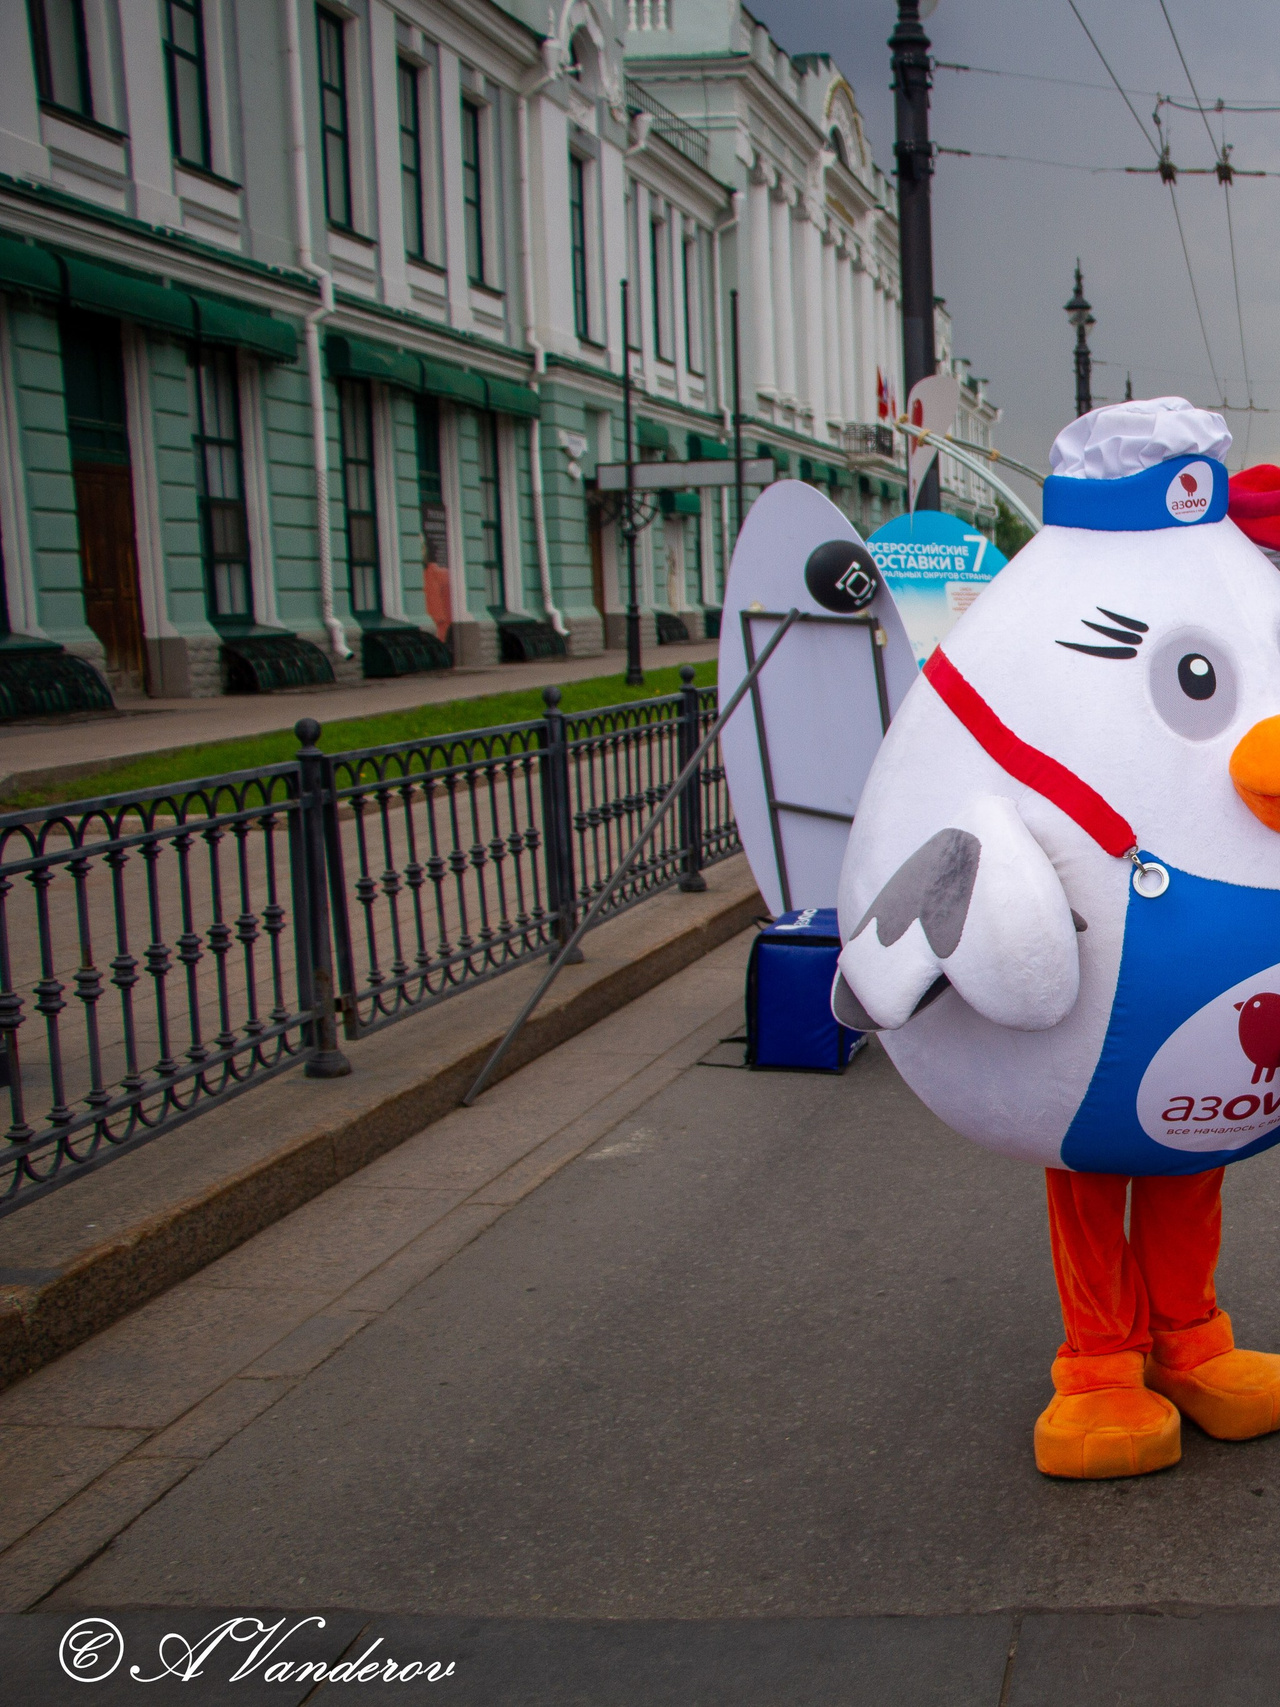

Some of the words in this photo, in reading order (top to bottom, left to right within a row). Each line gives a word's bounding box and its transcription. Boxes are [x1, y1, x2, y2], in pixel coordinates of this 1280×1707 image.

[866, 541, 969, 557] ВСЕРОССИЙСКИЕ
[873, 553, 951, 570] ОСТАВКИ
[954, 556, 966, 571] В
[963, 534, 988, 572] 7
[880, 569, 922, 579] РАЛЬНЫХ
[1193, 1125, 1255, 1135] началось
